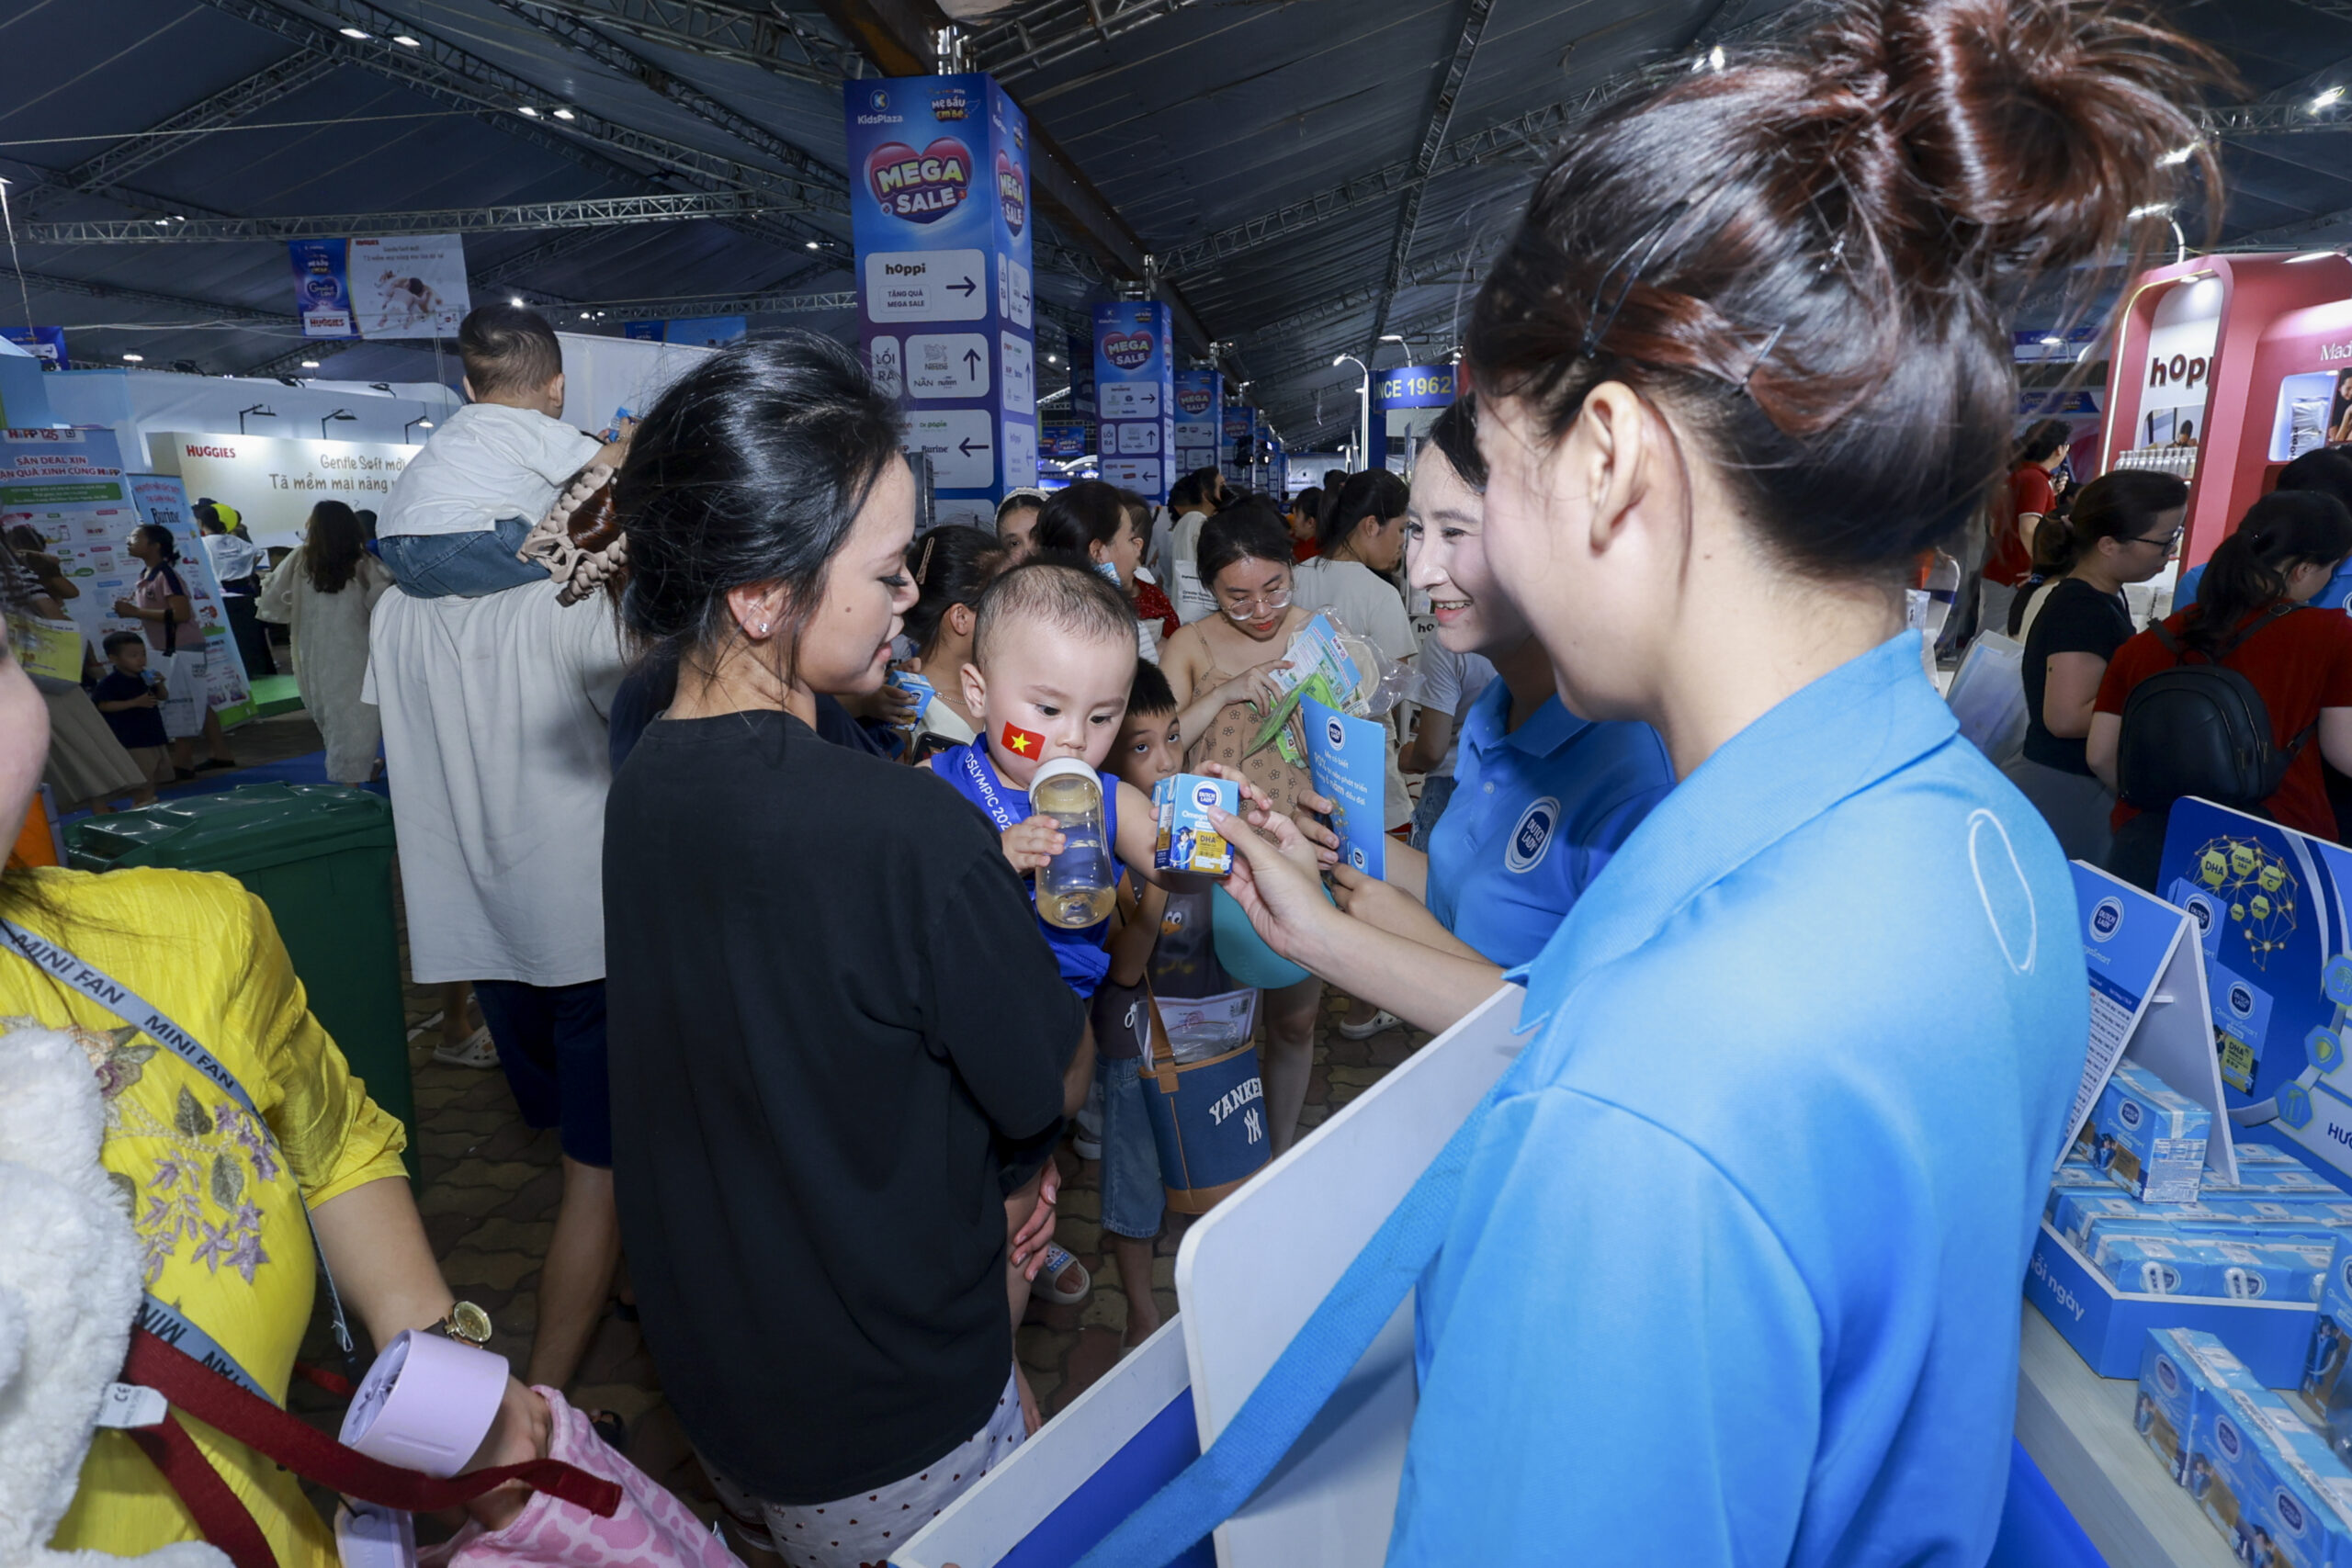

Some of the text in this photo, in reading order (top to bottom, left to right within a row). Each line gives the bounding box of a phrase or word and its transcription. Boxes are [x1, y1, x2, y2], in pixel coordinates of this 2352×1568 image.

[857, 114, 903, 125] KidsPlaza
[876, 160, 964, 193] MEGA
[1000, 173, 1024, 206] MEGA
[897, 187, 956, 214] SALE
[1004, 203, 1023, 225] SALE
[310, 318, 345, 328] HUGGIES
[876, 347, 896, 365] LỐI
[1107, 340, 1149, 355] MEGA
[2321, 341, 2352, 361] Mad
[1116, 353, 1146, 366] SALE
[877, 370, 895, 381] RA
[2149, 354, 2212, 389] hOp
[1376, 376, 1452, 399] NCE 1962
[187, 445, 236, 458] HUGGIES
[40, 457, 67, 465] DEAL
[321, 454, 357, 470] Gentle
[360, 456, 383, 471] Soft
[17, 468, 39, 478] QUÀ
[41, 468, 66, 476] XINH
[269, 471, 388, 493] Tã mềm mại nâng
[965, 750, 1012, 831] DSLYMPIC 202
[1198, 791, 1216, 799] DUTCH
[1182, 810, 1209, 820] Omega
[1200, 835, 1216, 843] DHA
[1527, 818, 1545, 843] DUTCH
[1521, 830, 1538, 852] LADY
[2205, 861, 2224, 876] DHA
[2098, 908, 2117, 922] DUTCH
[2190, 906, 2208, 919] DUTCH
[2098, 917, 2111, 929] LADY
[2083, 944, 2111, 964] gaSmart
[11, 933, 125, 1005] MINI FAN
[144, 1015, 234, 1089] MINI FAN
[2228, 1041, 2244, 1056] DHA
[1208, 1077, 1263, 1126] YANKE
[2048, 1273, 2088, 1321] ngày
